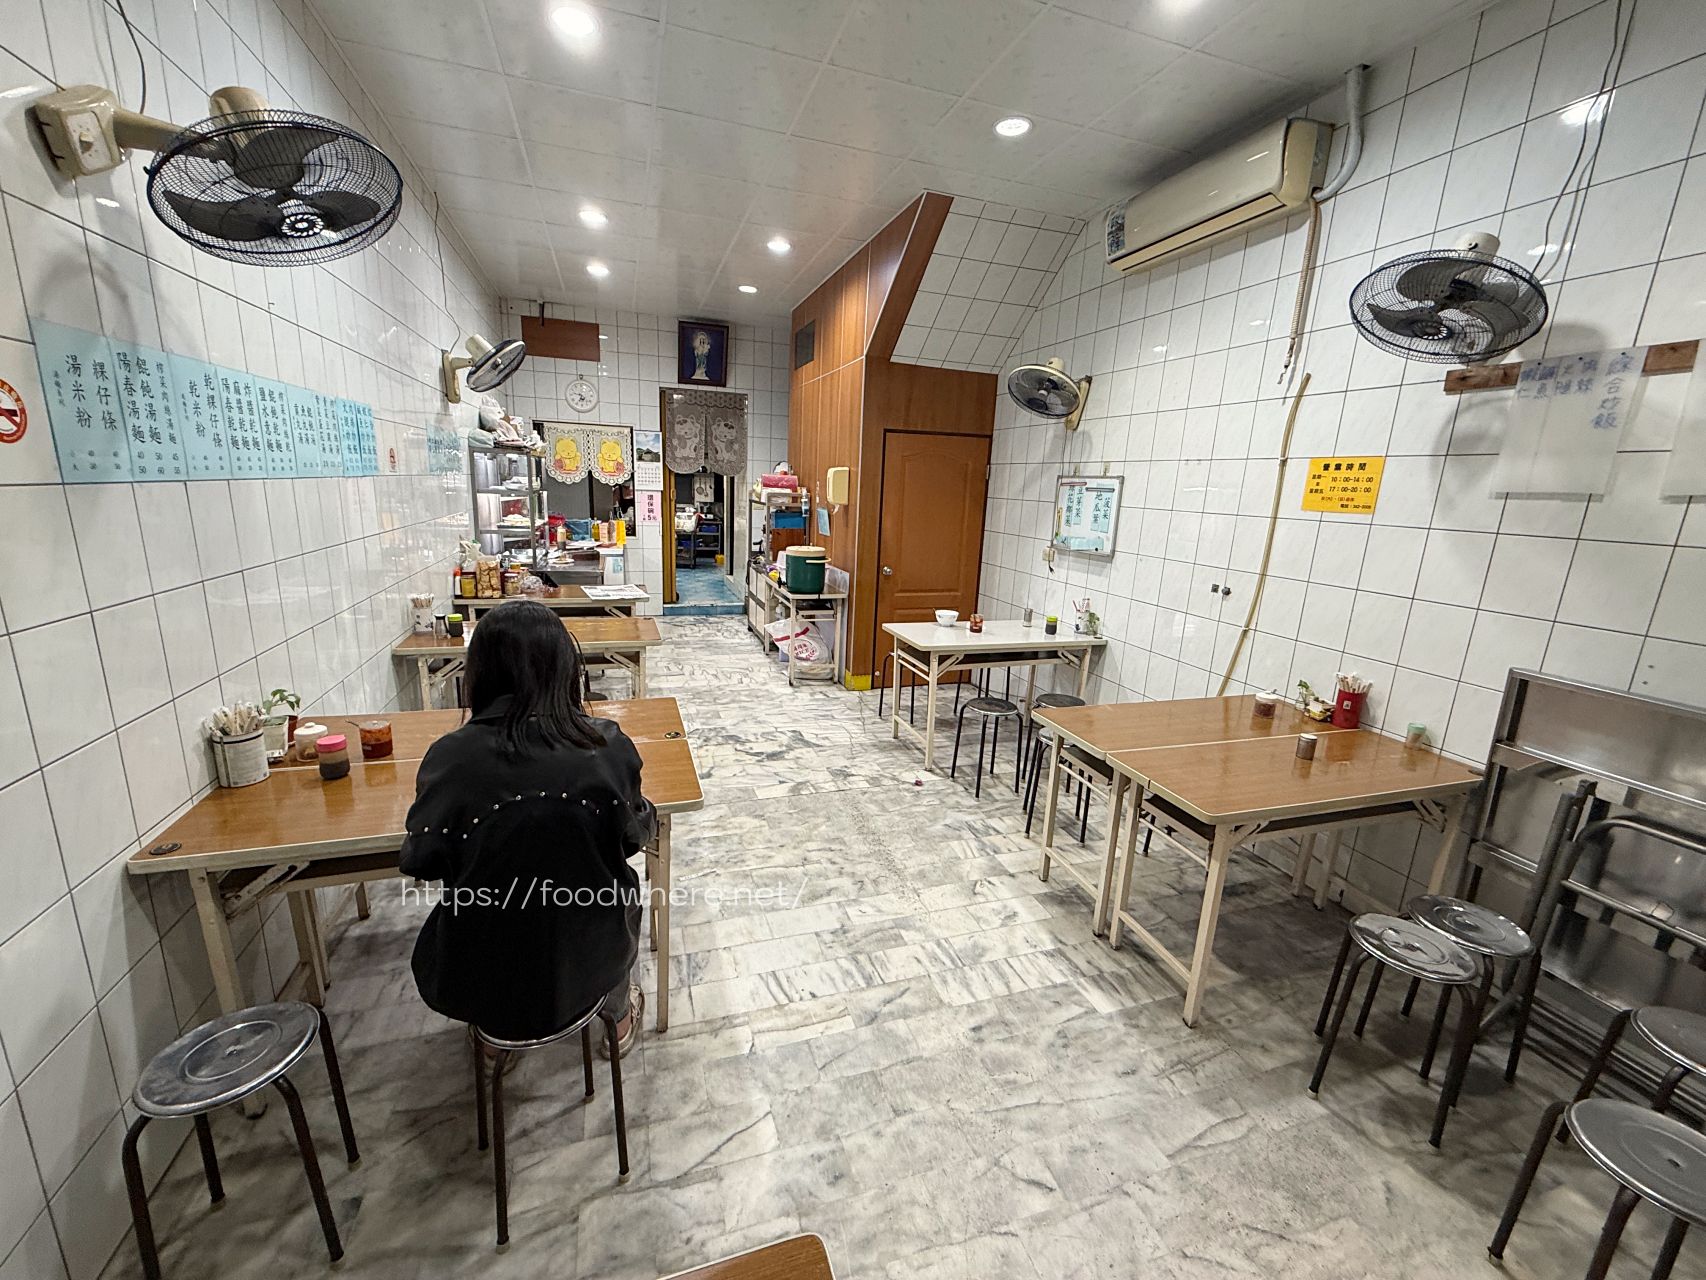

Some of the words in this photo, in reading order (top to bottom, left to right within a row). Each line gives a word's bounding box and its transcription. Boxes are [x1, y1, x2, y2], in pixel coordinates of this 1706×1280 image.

[65, 354, 92, 429] 湯米粉
[92, 360, 118, 431] 粿仔條
[116, 352, 146, 444] 陽春湯麵
[136, 356, 163, 445] 餛飩湯麵
[189, 380, 206, 438] 乾米粉
[204, 373, 223, 448] 乾粿仔條
[1323, 463, 1367, 471] 營業時間
